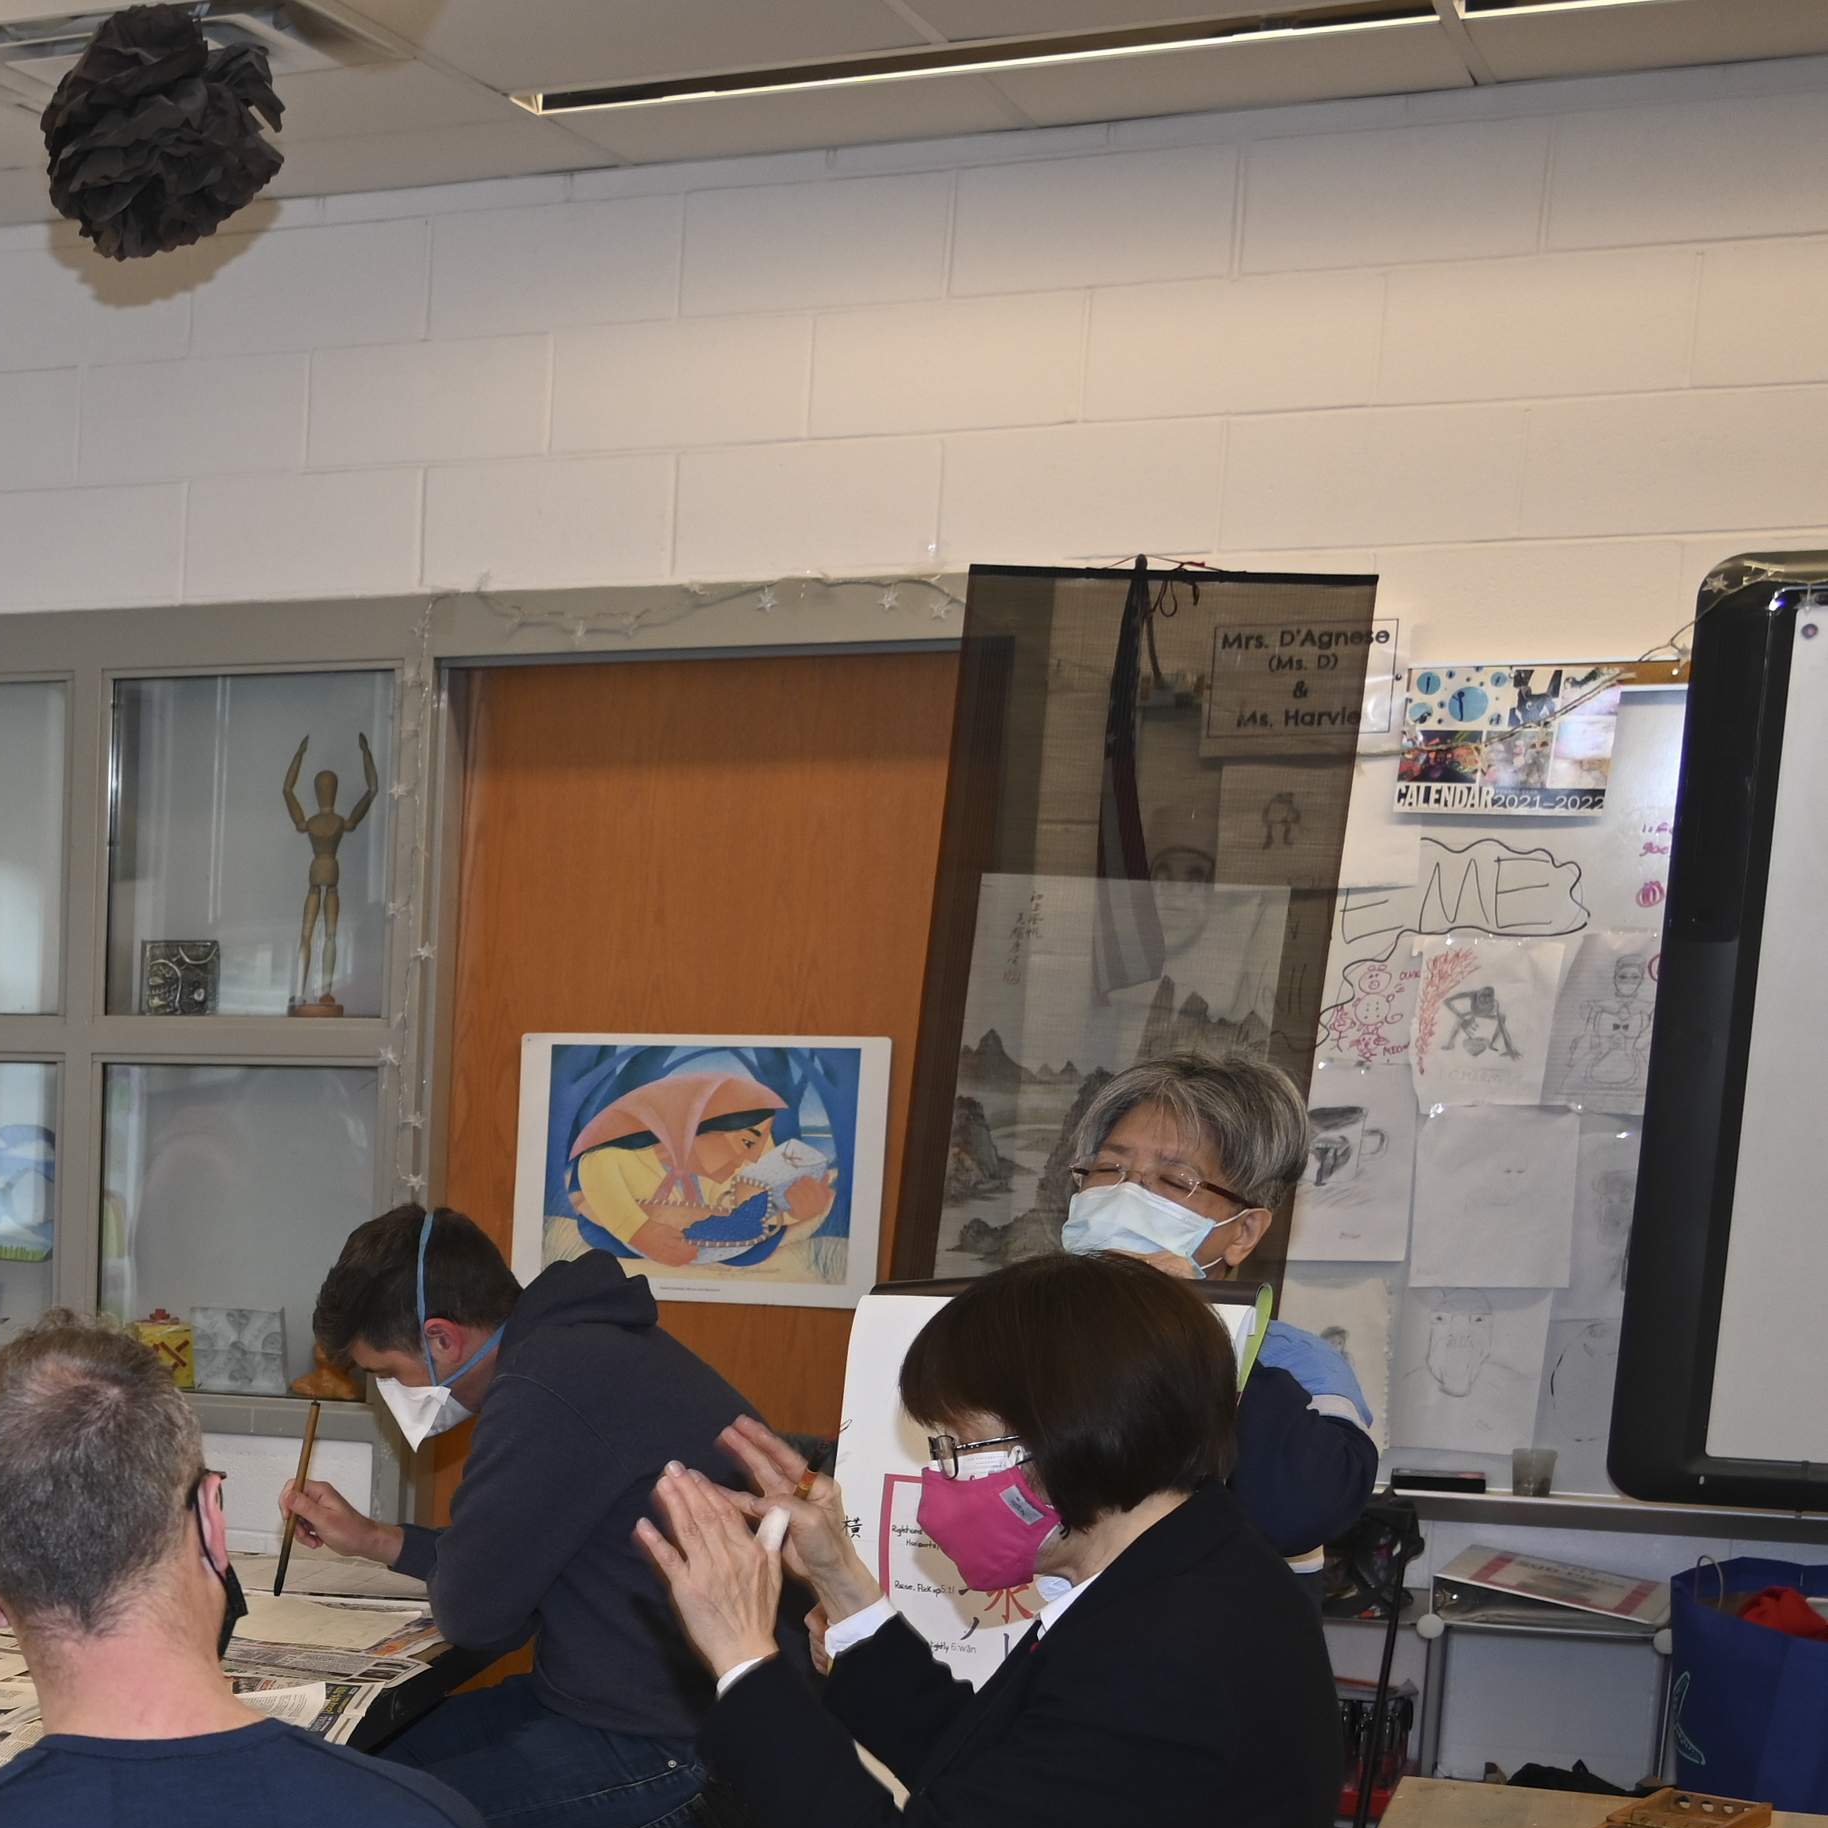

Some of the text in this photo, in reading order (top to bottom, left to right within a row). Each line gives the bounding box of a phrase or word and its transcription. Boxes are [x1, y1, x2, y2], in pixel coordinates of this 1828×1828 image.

[1221, 633, 1268, 650] Mrs.
[1268, 653, 1339, 672] (Ms. D)
[1292, 680, 1308, 699] &
[1236, 710, 1273, 728] Ms.
[1396, 784, 1494, 809] CALENDAR
